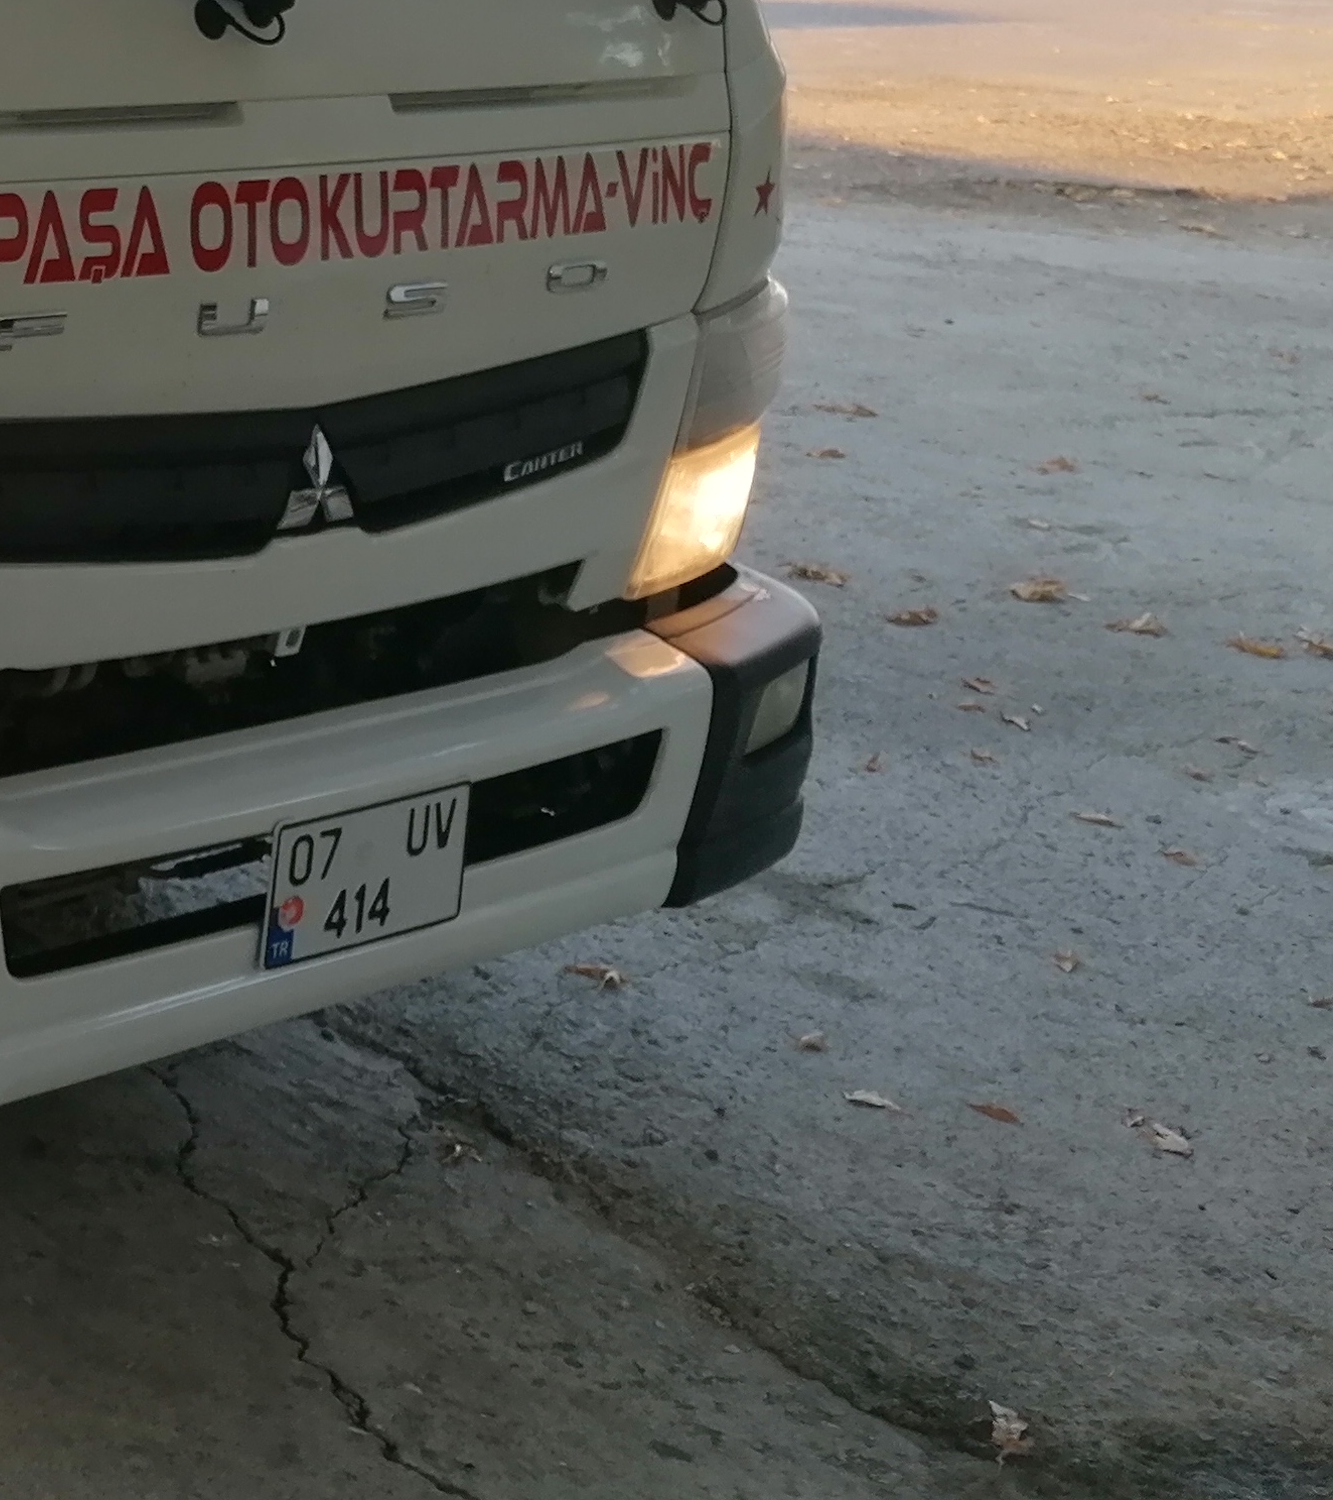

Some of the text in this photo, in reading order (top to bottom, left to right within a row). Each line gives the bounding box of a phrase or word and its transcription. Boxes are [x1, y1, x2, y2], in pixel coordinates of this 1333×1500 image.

[288, 797, 457, 887] 07 UV
[323, 876, 391, 939] 414
[270, 940, 290, 959] TR
